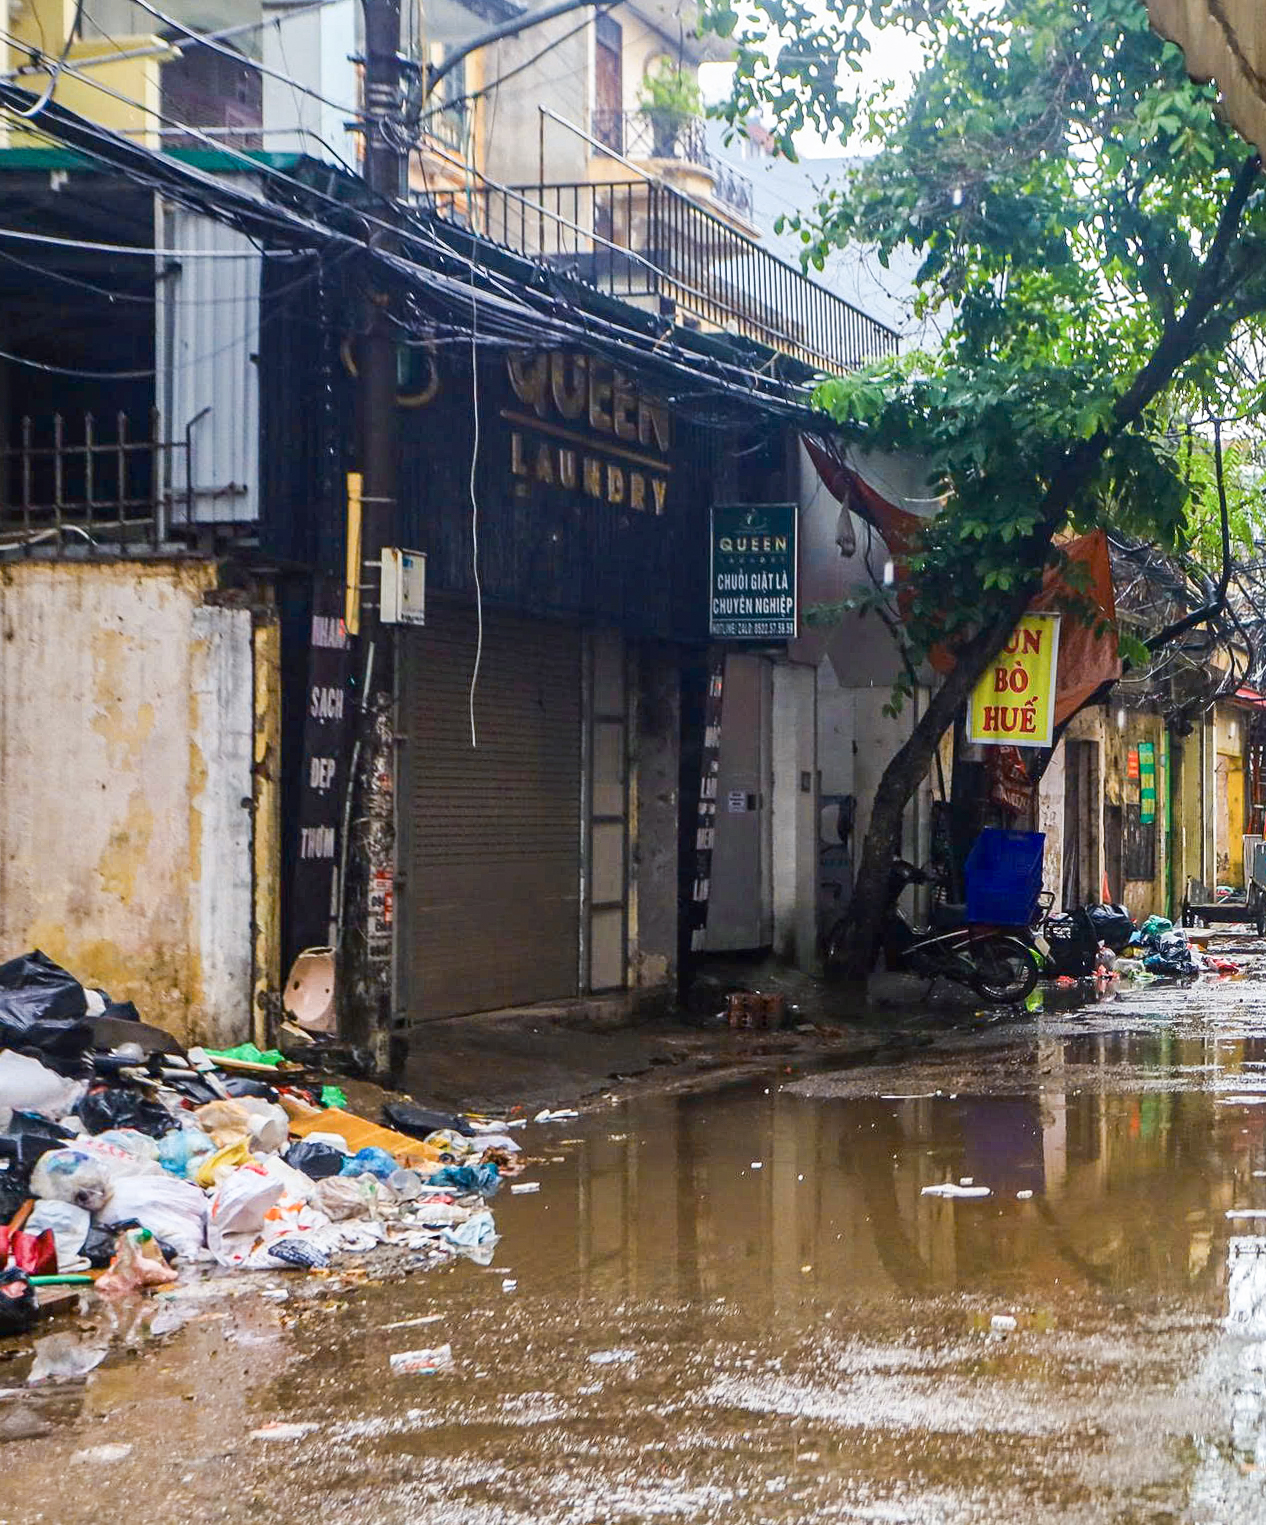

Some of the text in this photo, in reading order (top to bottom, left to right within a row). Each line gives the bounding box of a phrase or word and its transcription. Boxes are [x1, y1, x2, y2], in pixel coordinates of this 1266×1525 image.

[512, 432, 667, 516] LAUNDRY
[720, 537, 787, 552] QUEEN
[775, 569, 789, 590] LÀ
[994, 660, 1028, 692] BÒ
[982, 696, 1038, 733] HUẾ
